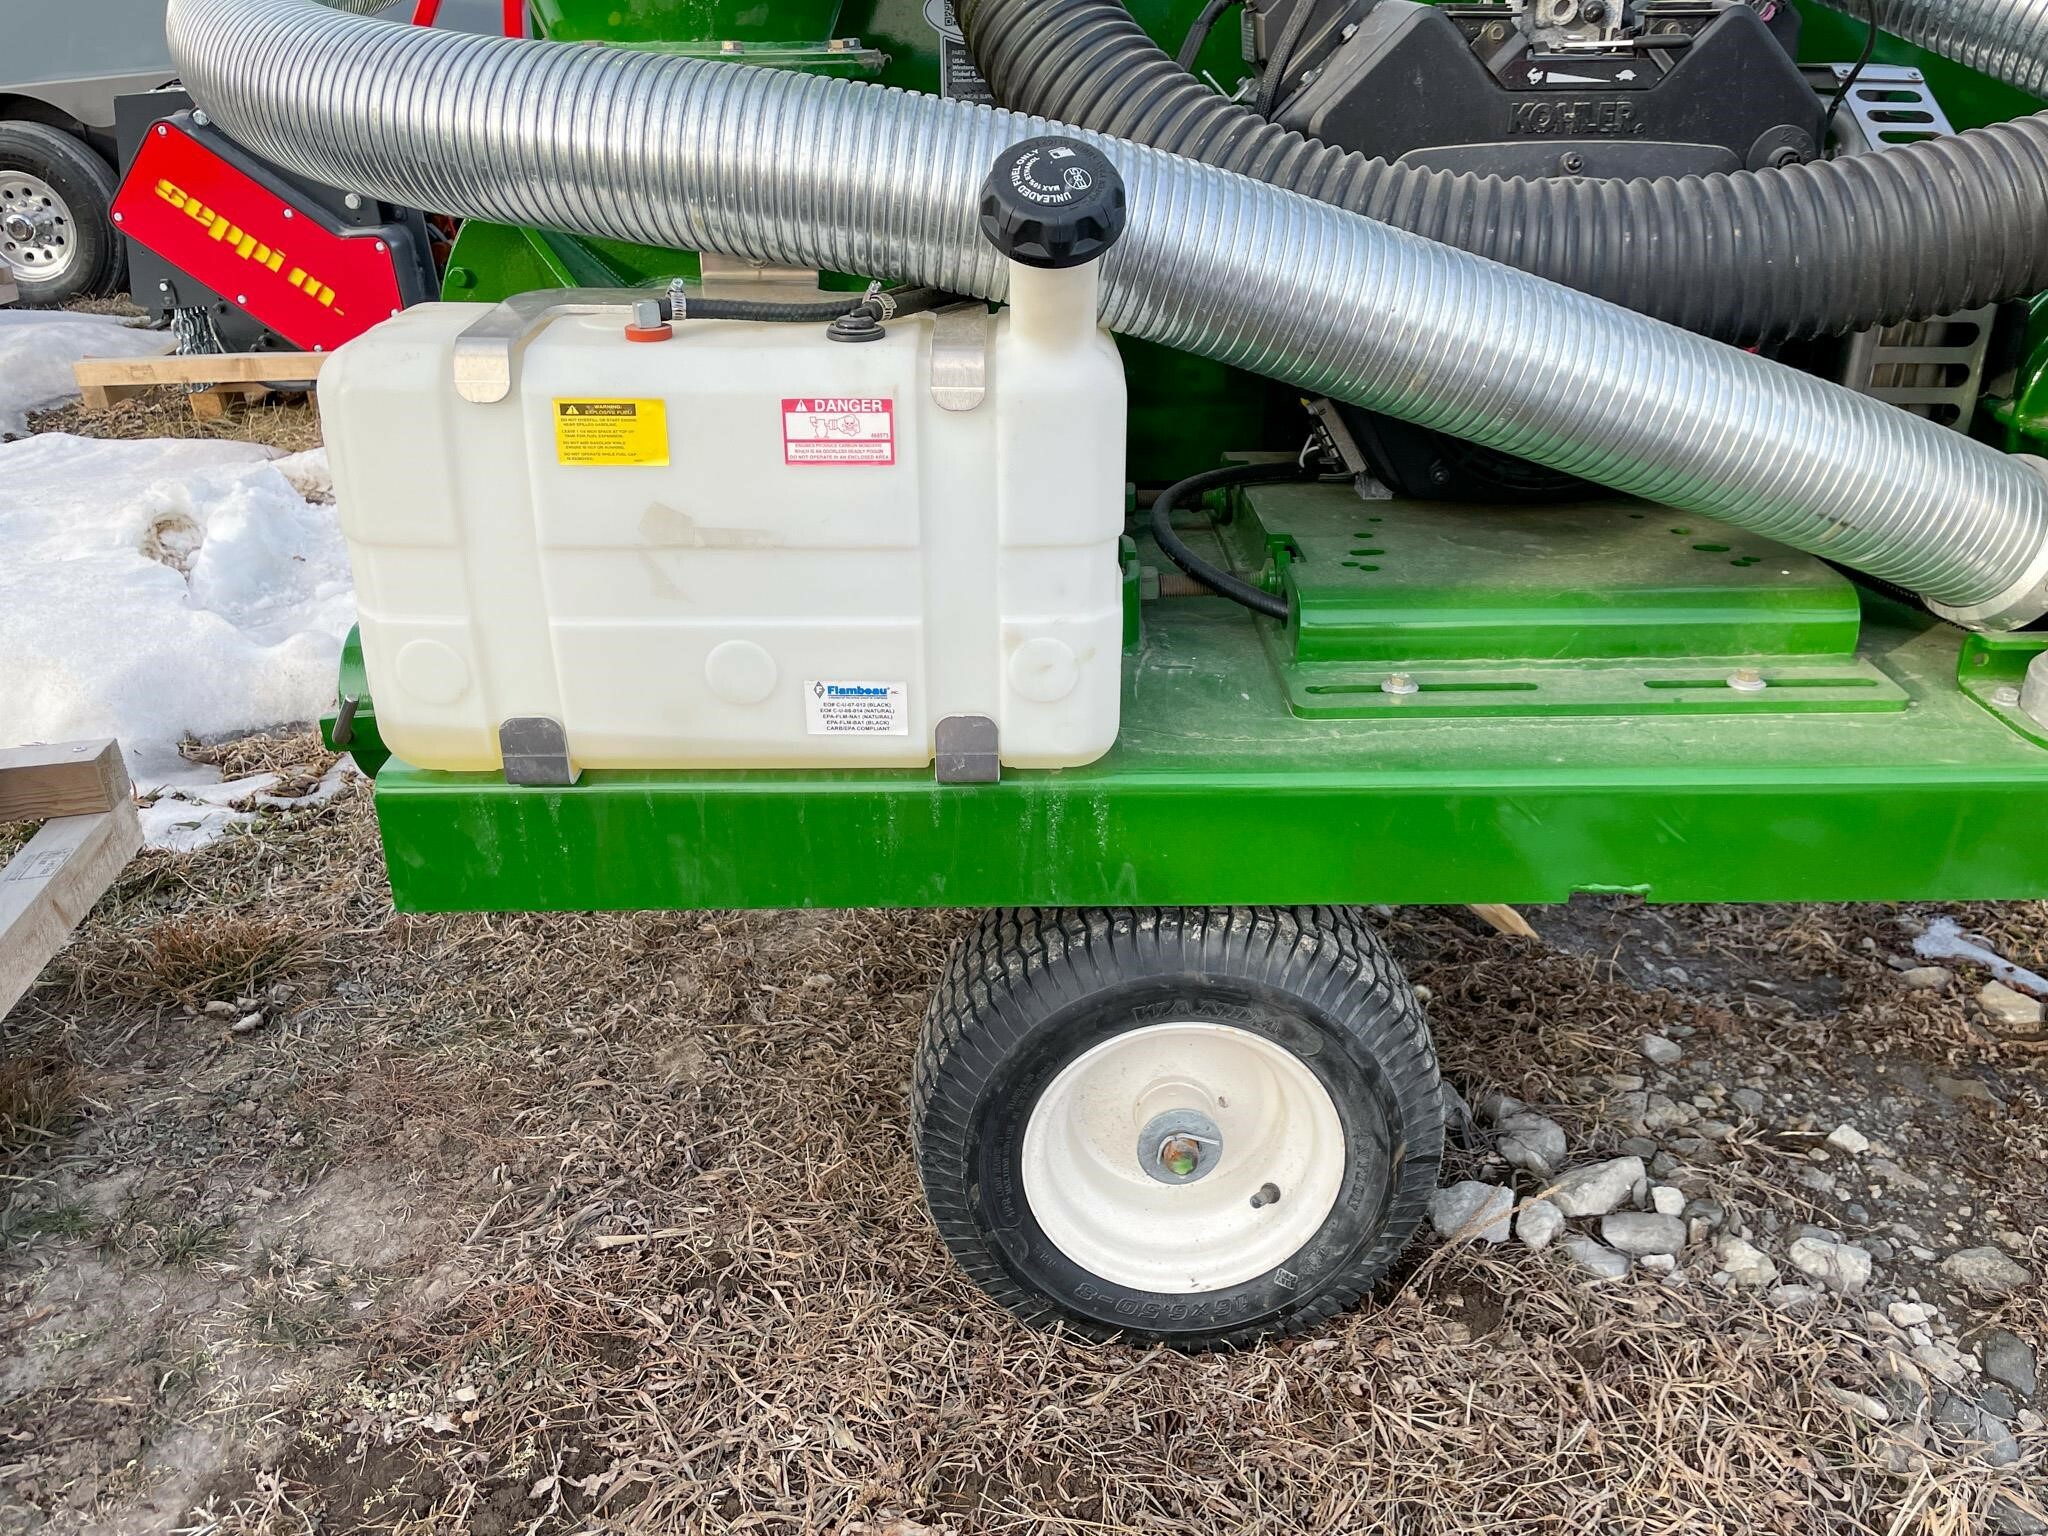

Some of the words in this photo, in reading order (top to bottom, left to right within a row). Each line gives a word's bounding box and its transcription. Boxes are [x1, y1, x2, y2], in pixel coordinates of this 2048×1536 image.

[1506, 101, 1635, 134] KOHLER
[1016, 148, 1039, 165] ONLY
[1010, 164, 1021, 187] FUEL
[1024, 156, 1040, 180] ETHANOL
[1069, 168, 1087, 189] E85
[1018, 184, 1072, 203] UNLEADED
[154, 178, 286, 273] seppi
[814, 400, 883, 412] DANGER
